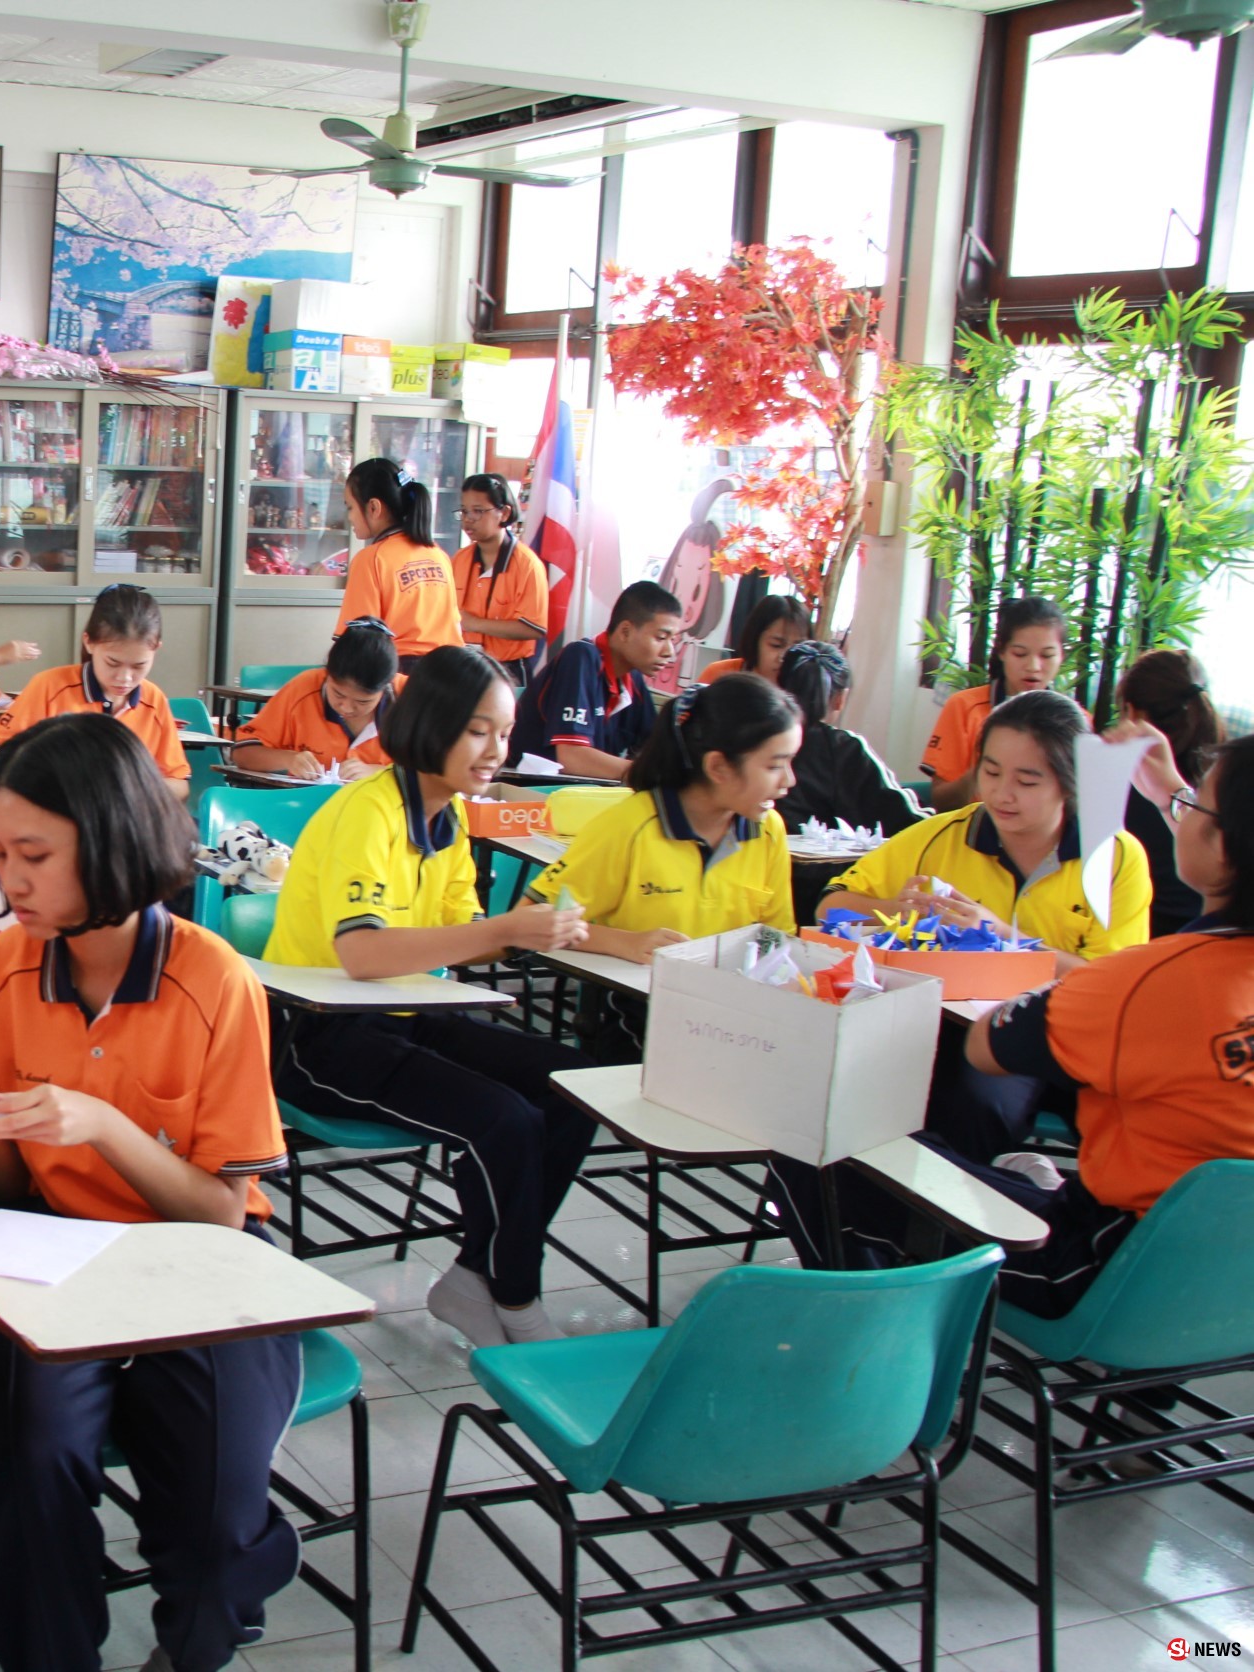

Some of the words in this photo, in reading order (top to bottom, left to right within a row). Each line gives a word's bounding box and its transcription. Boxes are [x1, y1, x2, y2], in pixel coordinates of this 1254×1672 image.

[295, 334, 331, 346] Double
[391, 368, 426, 390] plus
[400, 566, 444, 586] SPORTS
[499, 808, 548, 834] idea
